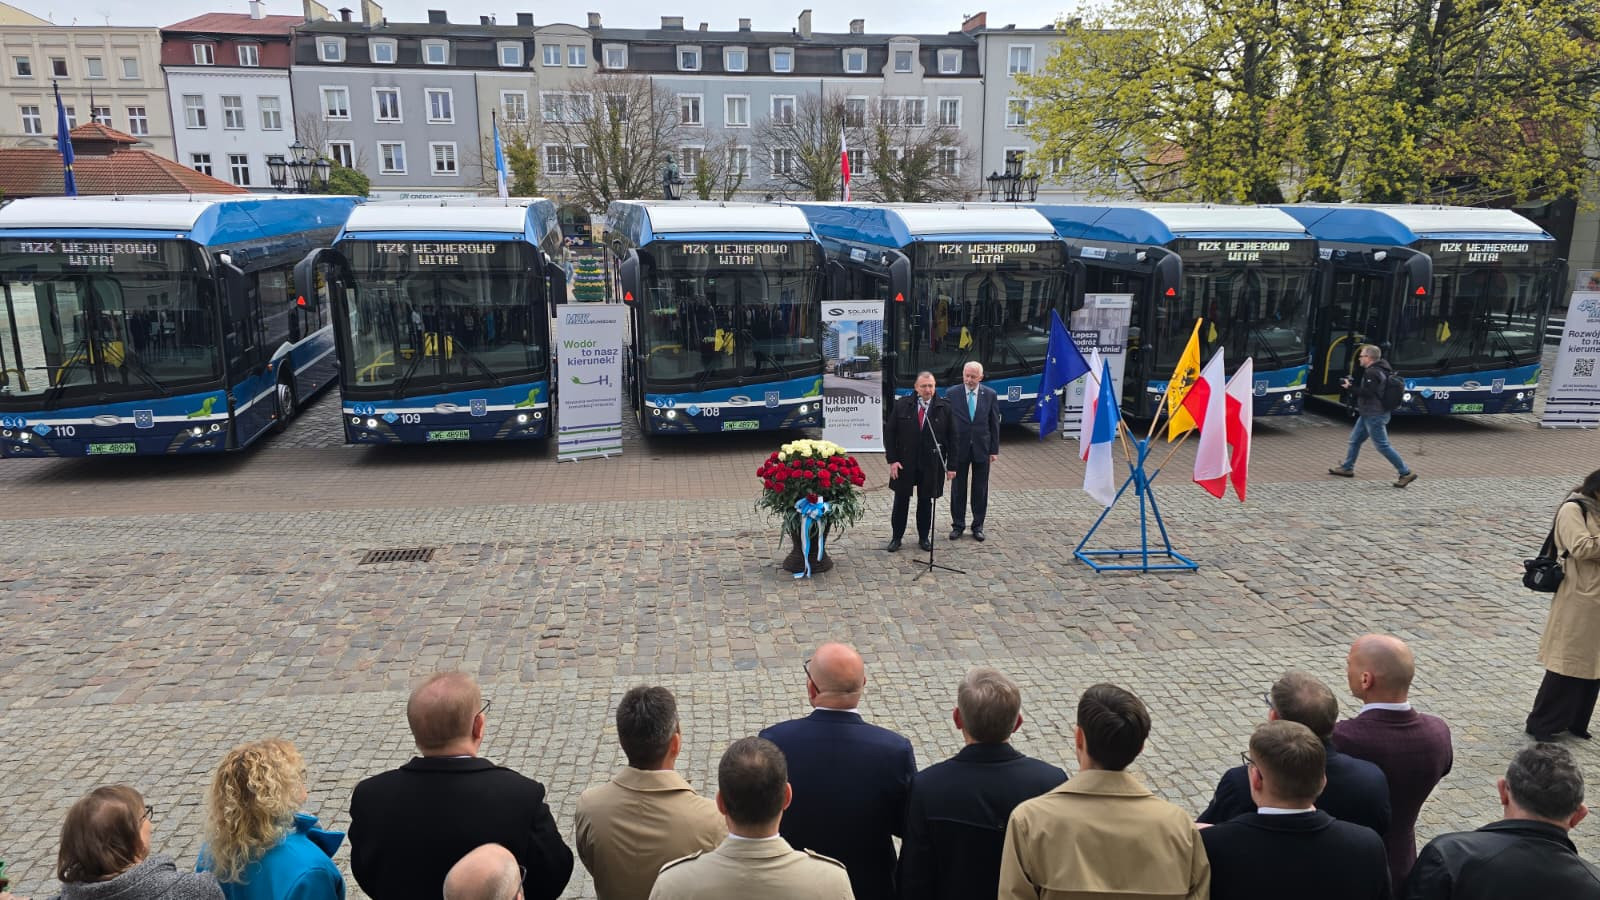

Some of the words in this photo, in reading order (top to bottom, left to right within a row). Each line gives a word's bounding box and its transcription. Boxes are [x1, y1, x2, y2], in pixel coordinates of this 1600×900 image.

[20, 242, 55, 253] MZK
[61, 243, 157, 254] WEJHEROWO
[376, 243, 407, 253] MZK
[413, 243, 496, 254] WEJHEROWO
[683, 244, 708, 254] MZK
[714, 244, 788, 254] WEJHEROWO
[939, 244, 962, 253] MZK
[968, 243, 1036, 253] WEJHEROWO
[1198, 241, 1221, 251] MZK
[1225, 242, 1290, 251] WEJHEROWO
[1440, 243, 1462, 252] MZK
[1466, 243, 1529, 252] WEJHEROWO
[69, 255, 115, 265] WITA!
[418, 254, 459, 265] WITA!
[719, 255, 754, 265] WITA!
[971, 254, 1004, 263] WITA!
[1228, 252, 1260, 261] WITA!
[1468, 253, 1500, 262] WITA!
[563, 340, 597, 349] Wodór
[1568, 344, 1600, 353] kierune
[582, 348, 592, 356] to
[594, 348, 619, 356] nasz
[567, 355, 616, 366] kierunek!
[825, 395, 866, 405] URBINO
[1433, 391, 1450, 399] 105
[701, 407, 720, 416] 108
[825, 405, 858, 413] hydrogen
[400, 413, 421, 424] 109
[54, 425, 76, 437] 110
